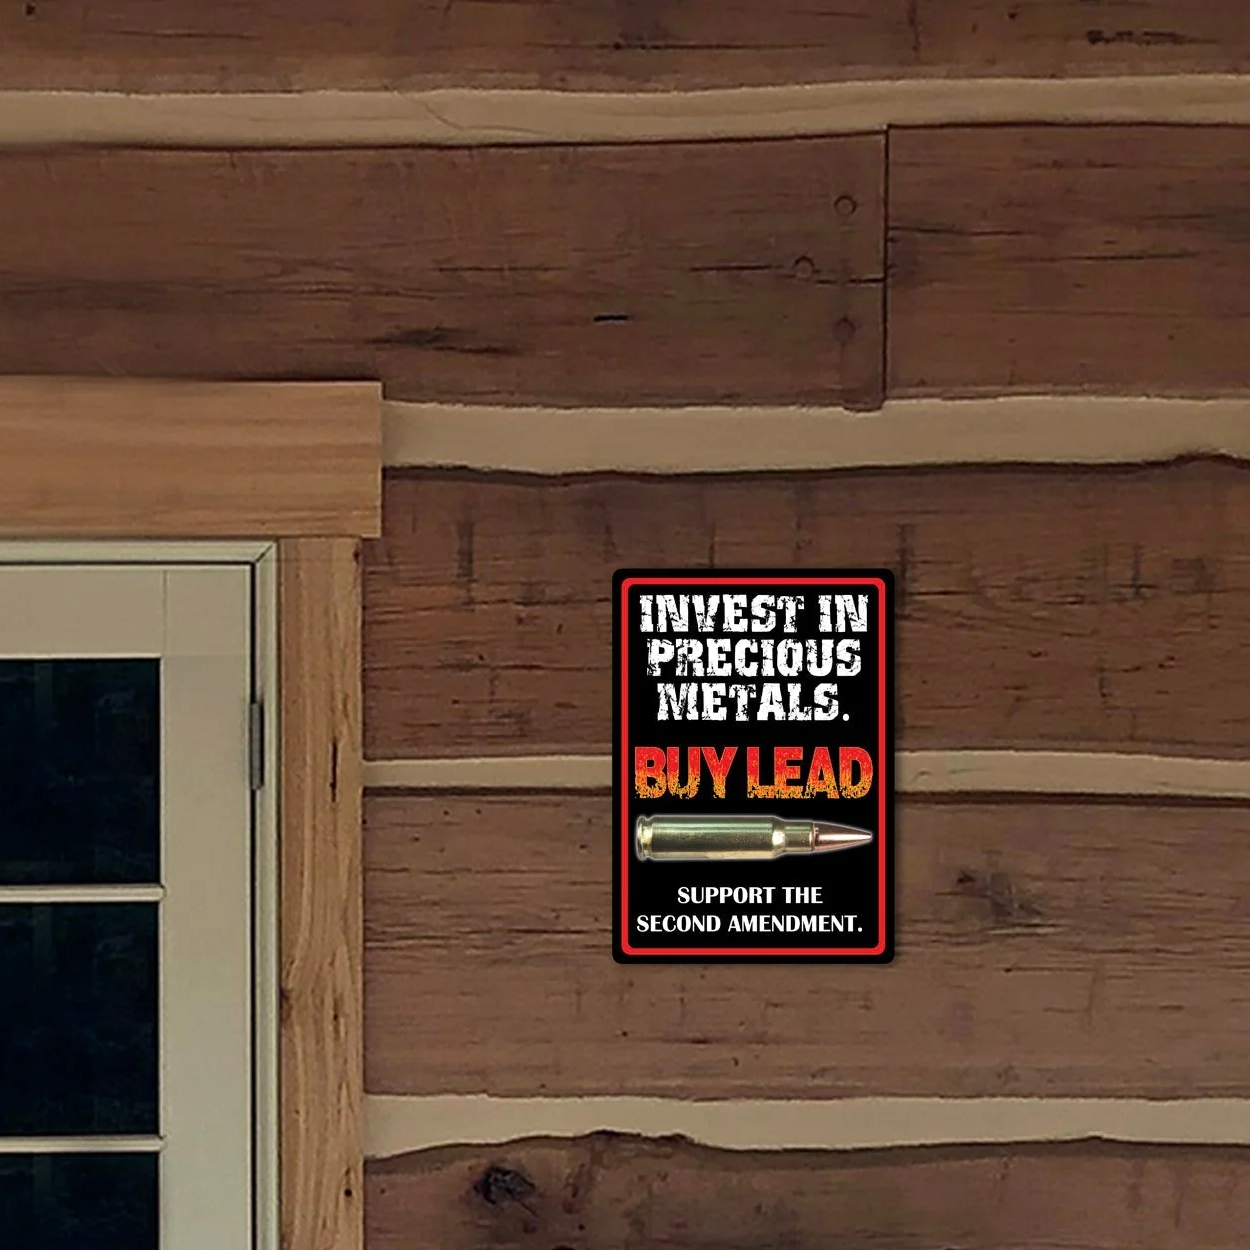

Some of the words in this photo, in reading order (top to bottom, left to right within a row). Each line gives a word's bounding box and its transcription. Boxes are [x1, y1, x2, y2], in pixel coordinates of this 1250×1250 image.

[639, 594, 805, 632] INVEST
[818, 594, 868, 632] IN
[646, 639, 862, 677] PRECIOUS
[656, 683, 850, 721] METALS.
[634, 746, 738, 799] BUY
[747, 746, 874, 799] LEAD
[677, 886, 776, 904] SUPPORT
[781, 886, 824, 904] THE
[636, 914, 722, 933] SECOND
[727, 914, 863, 933] AMENDMENT.
